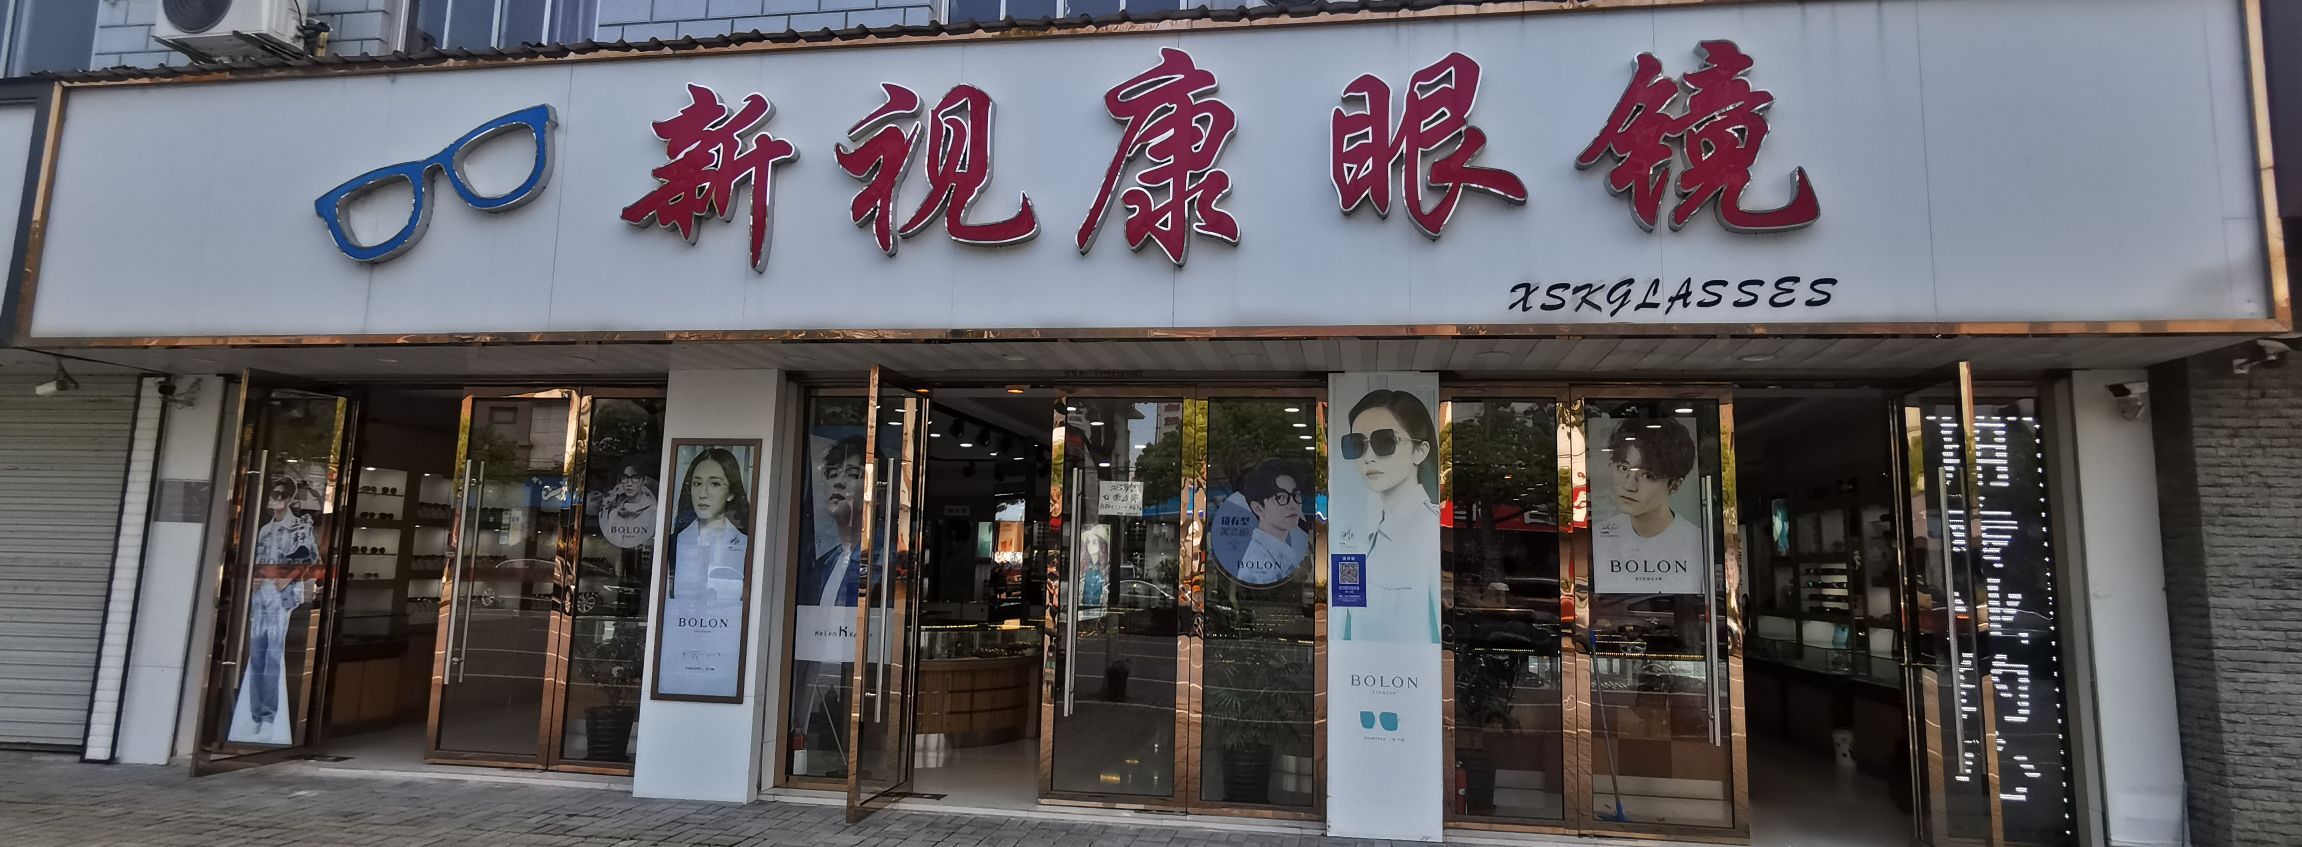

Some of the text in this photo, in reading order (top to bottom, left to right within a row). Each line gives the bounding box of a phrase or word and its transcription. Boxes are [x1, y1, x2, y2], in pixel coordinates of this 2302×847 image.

[620, 38, 1822, 273] 新视康眼镜
[1508, 275, 1839, 318] XSKGLASSES
[610, 525, 648, 534] BOLON
[1237, 560, 1282, 570] BOLON
[1610, 559, 1687, 573] BOLON
[678, 617, 729, 629] BOLON
[1350, 674, 1418, 689] BOLON
